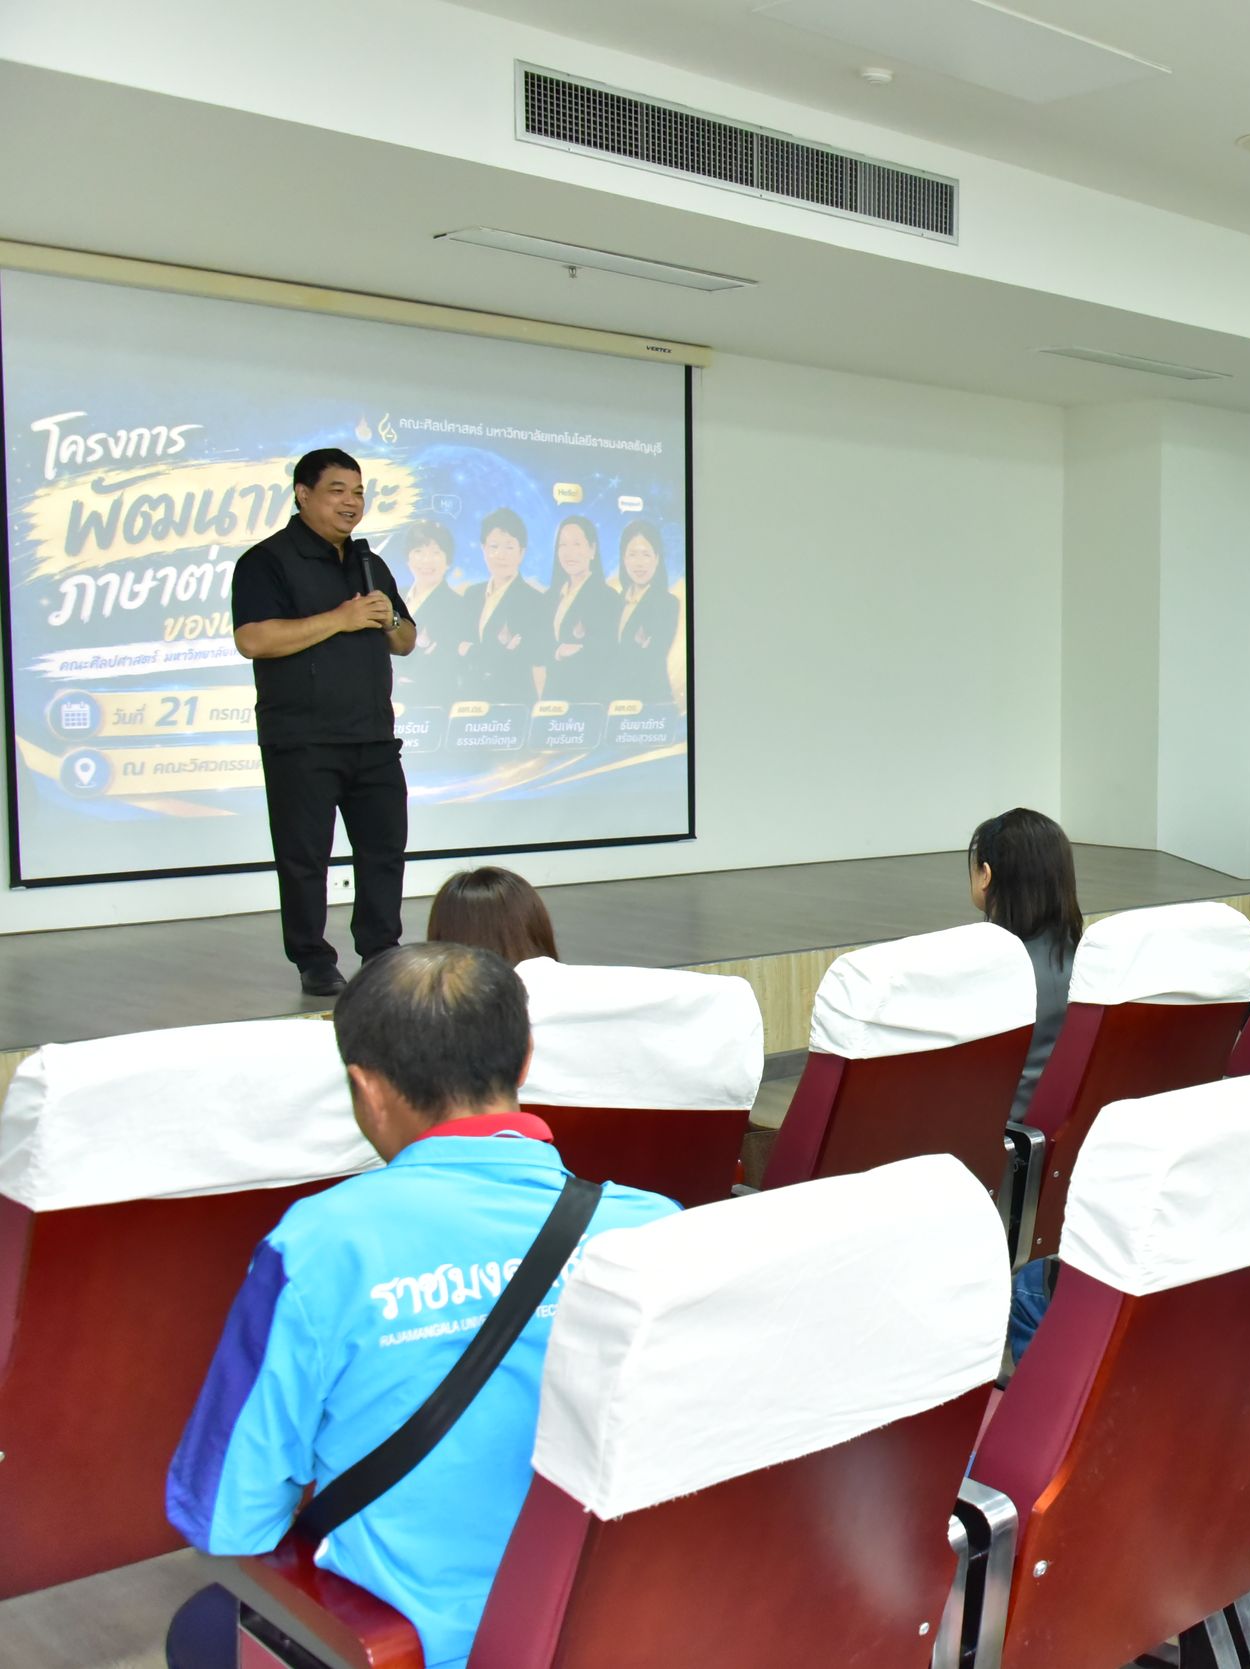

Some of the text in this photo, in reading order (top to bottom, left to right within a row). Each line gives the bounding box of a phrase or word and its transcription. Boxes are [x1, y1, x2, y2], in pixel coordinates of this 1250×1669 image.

[31, 411, 203, 480] โครงการ
[48, 545, 234, 626] ภาษาต่า
[112, 704, 146, 725] วันที่
[155, 696, 198, 727] 21
[122, 761, 145, 776] ณ
